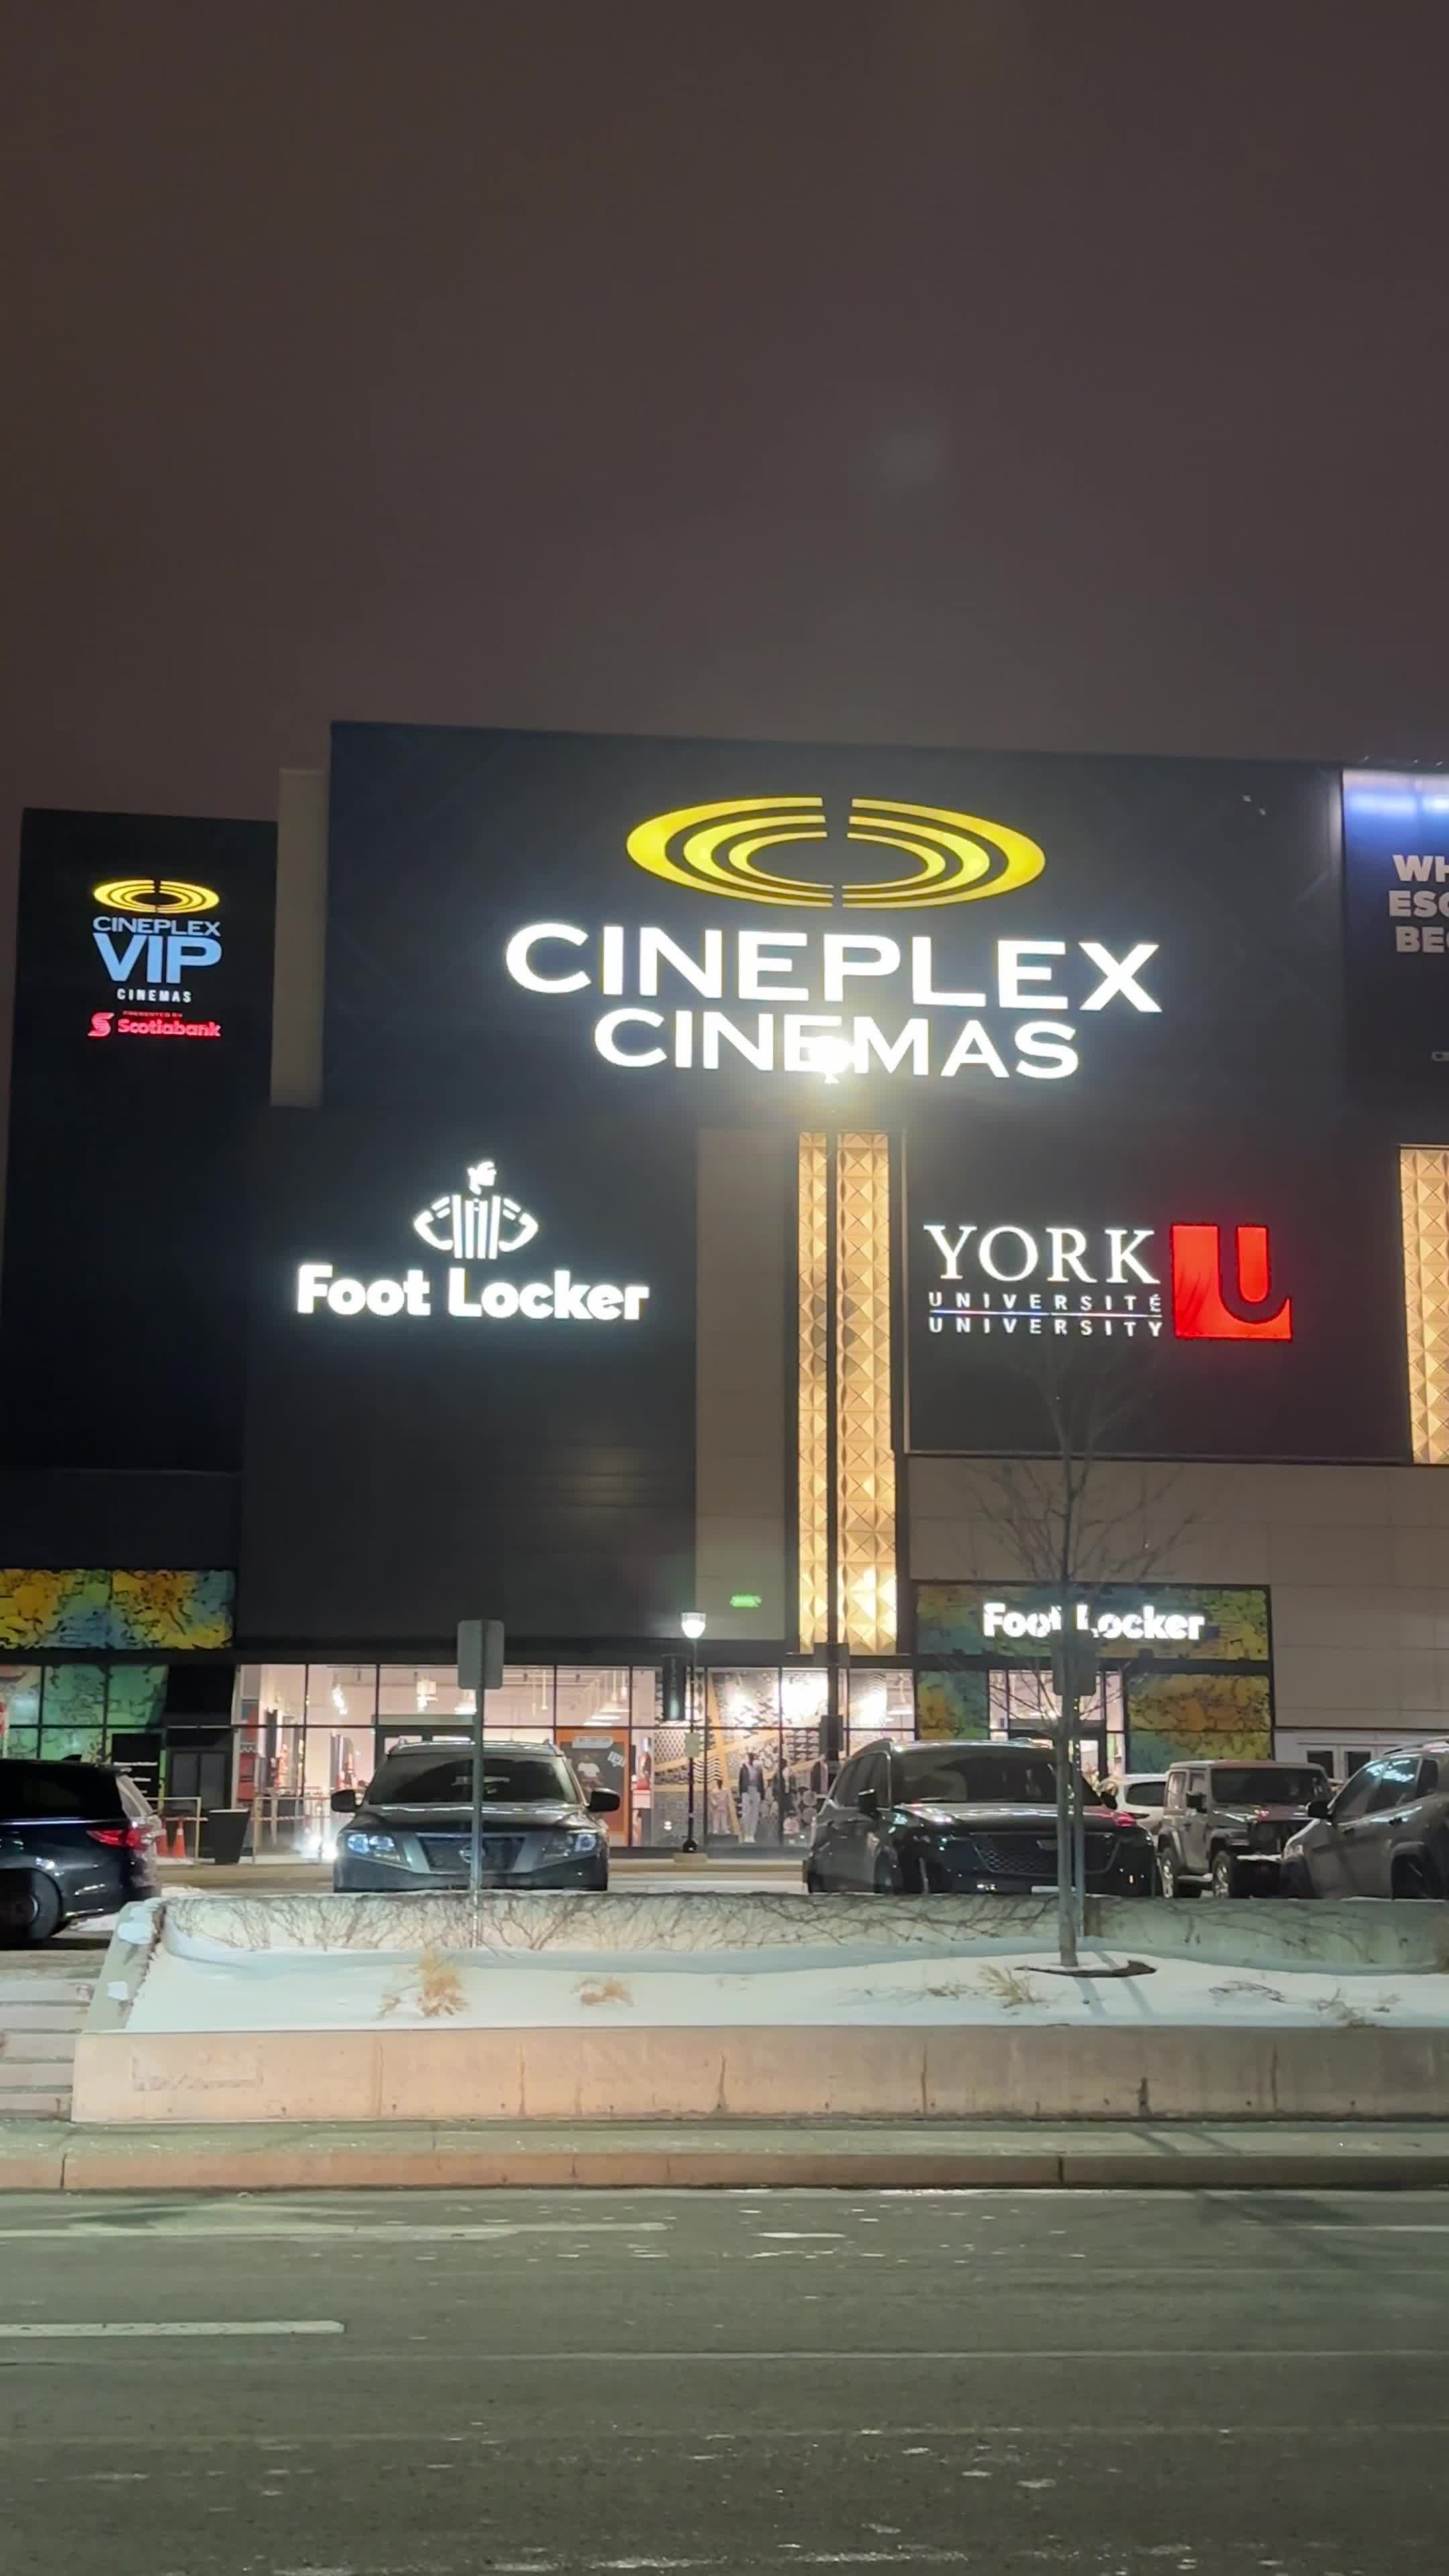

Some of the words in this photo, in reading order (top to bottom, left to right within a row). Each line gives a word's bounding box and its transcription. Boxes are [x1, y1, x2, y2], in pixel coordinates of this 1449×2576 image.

[93, 916, 220, 936] CINEPLEX
[1395, 926, 1449, 953] BE
[93, 933, 222, 984] VIP
[506, 923, 1162, 1012] CINEPLEX
[117, 988, 193, 1003] CINEMAS
[117, 1018, 221, 1036] Scotiabank
[594, 1008, 1079, 1079] CINEMAS
[923, 1225, 1160, 1284] YORK
[297, 1264, 431, 1316] Foot
[448, 1267, 649, 1320] Locker
[928, 1292, 1161, 1312] UNIVERSITÉ
[928, 1317, 1163, 1337] UNIVERSITY
